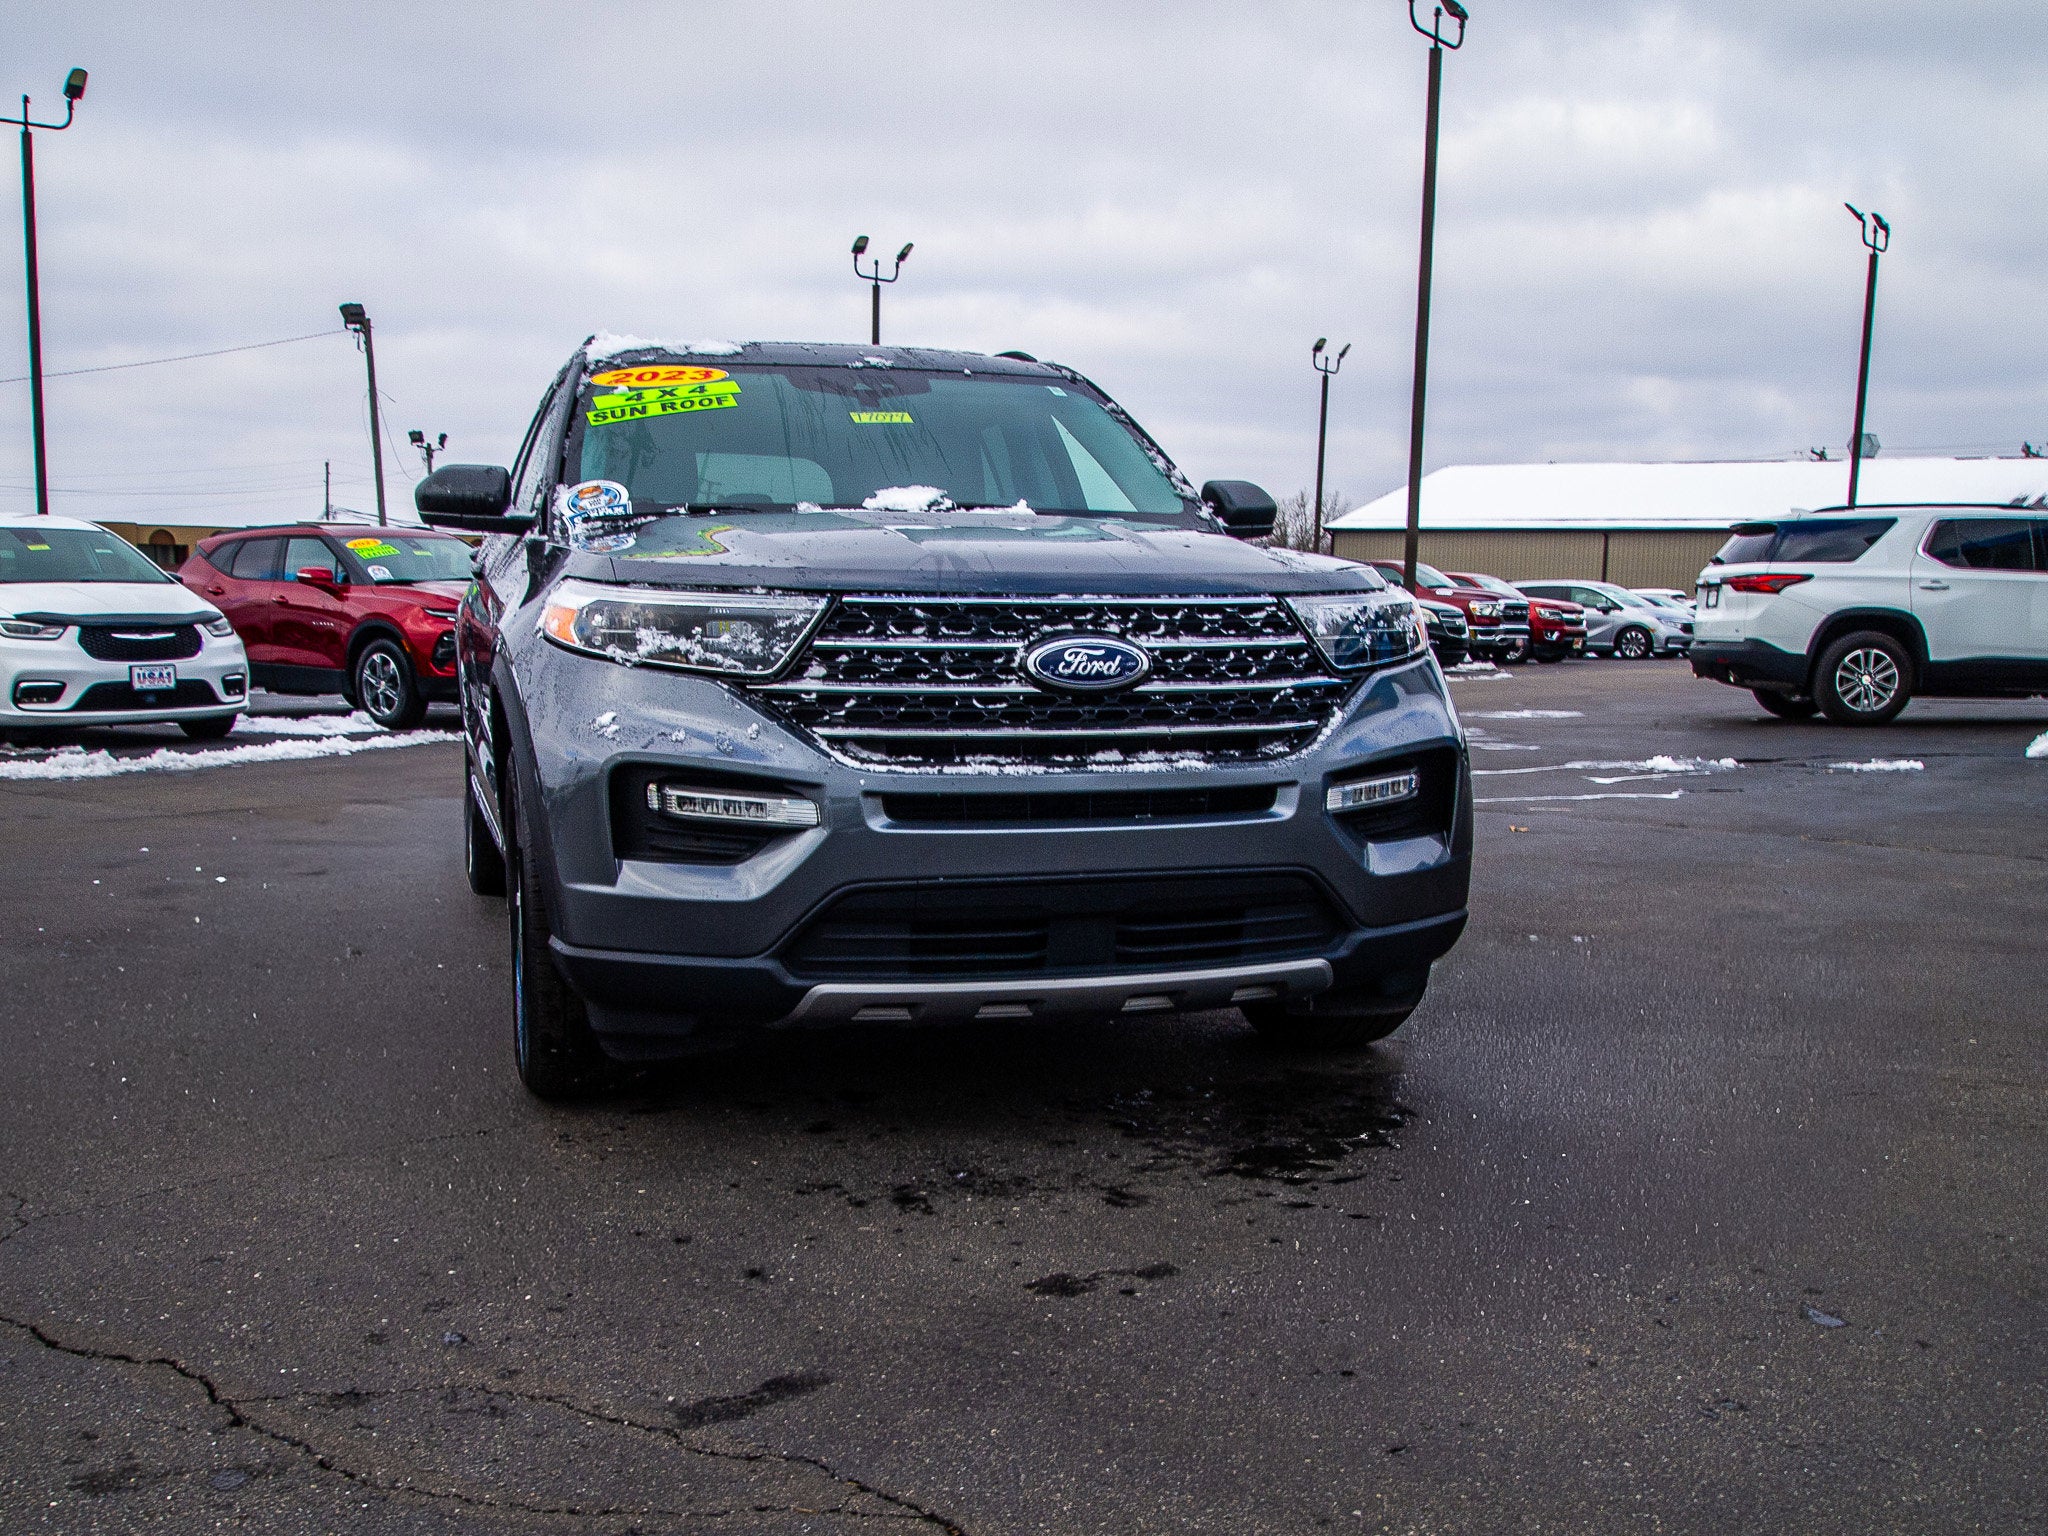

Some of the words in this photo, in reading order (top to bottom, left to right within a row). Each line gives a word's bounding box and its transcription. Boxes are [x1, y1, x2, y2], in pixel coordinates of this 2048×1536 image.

[607, 371, 713, 384] 2023
[593, 406, 647, 422] SUN
[661, 396, 729, 412] ROOF
[1058, 647, 1122, 676] Ford
